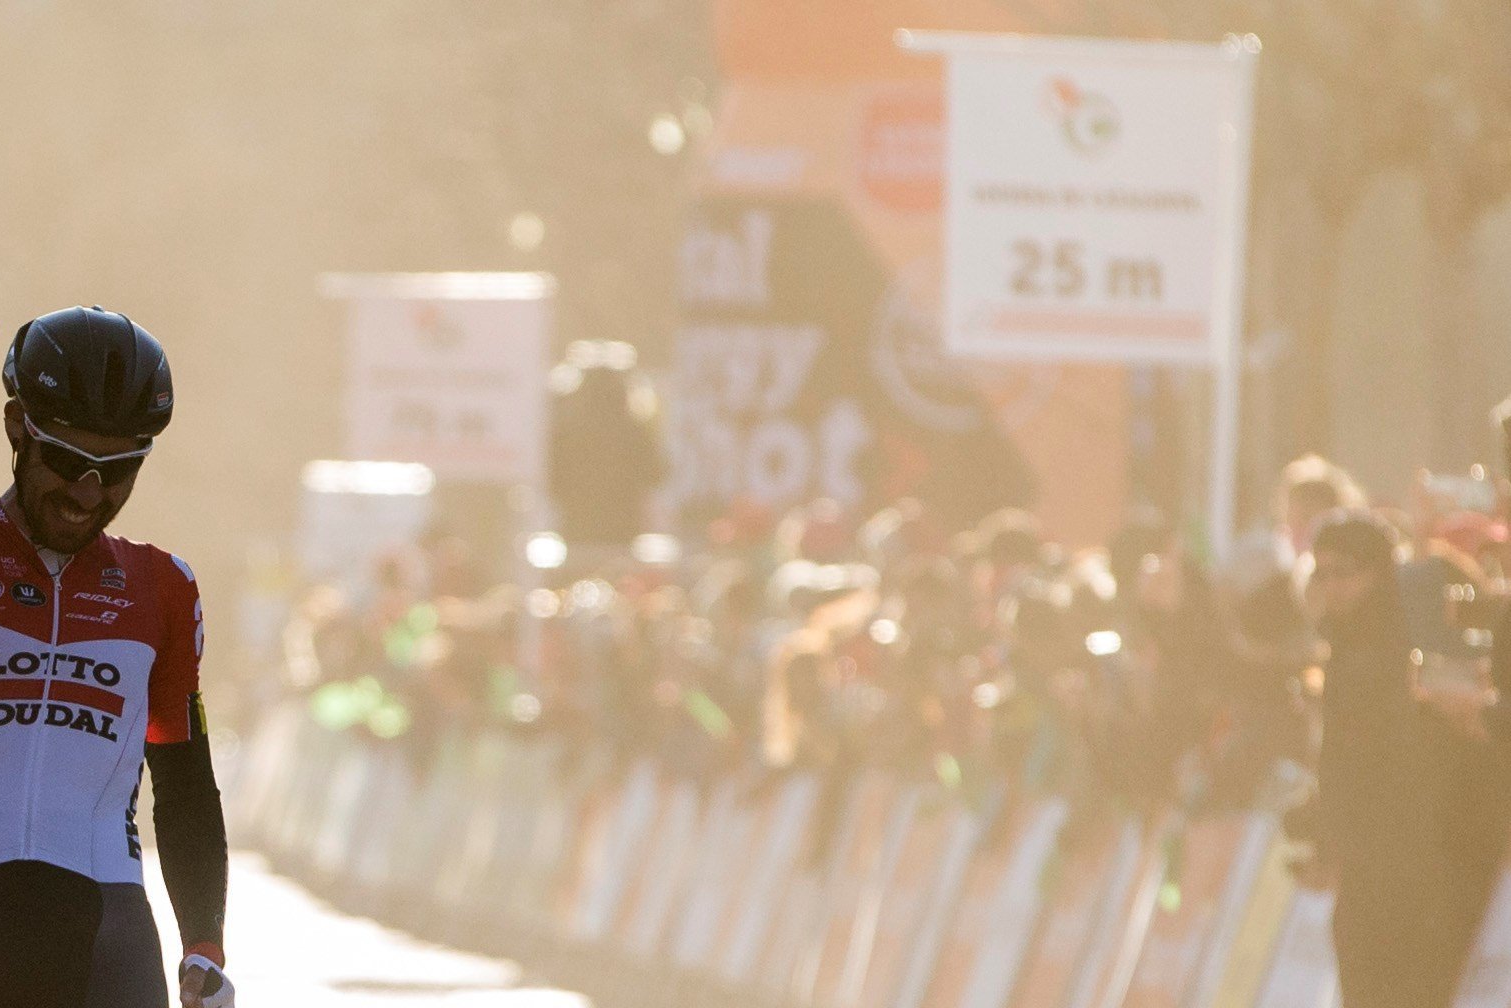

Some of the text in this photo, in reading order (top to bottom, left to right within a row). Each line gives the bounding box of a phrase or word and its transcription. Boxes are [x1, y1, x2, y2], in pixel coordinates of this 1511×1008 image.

[1008, 238, 1165, 300] 25 m
[73, 591, 135, 609] RIDLEY
